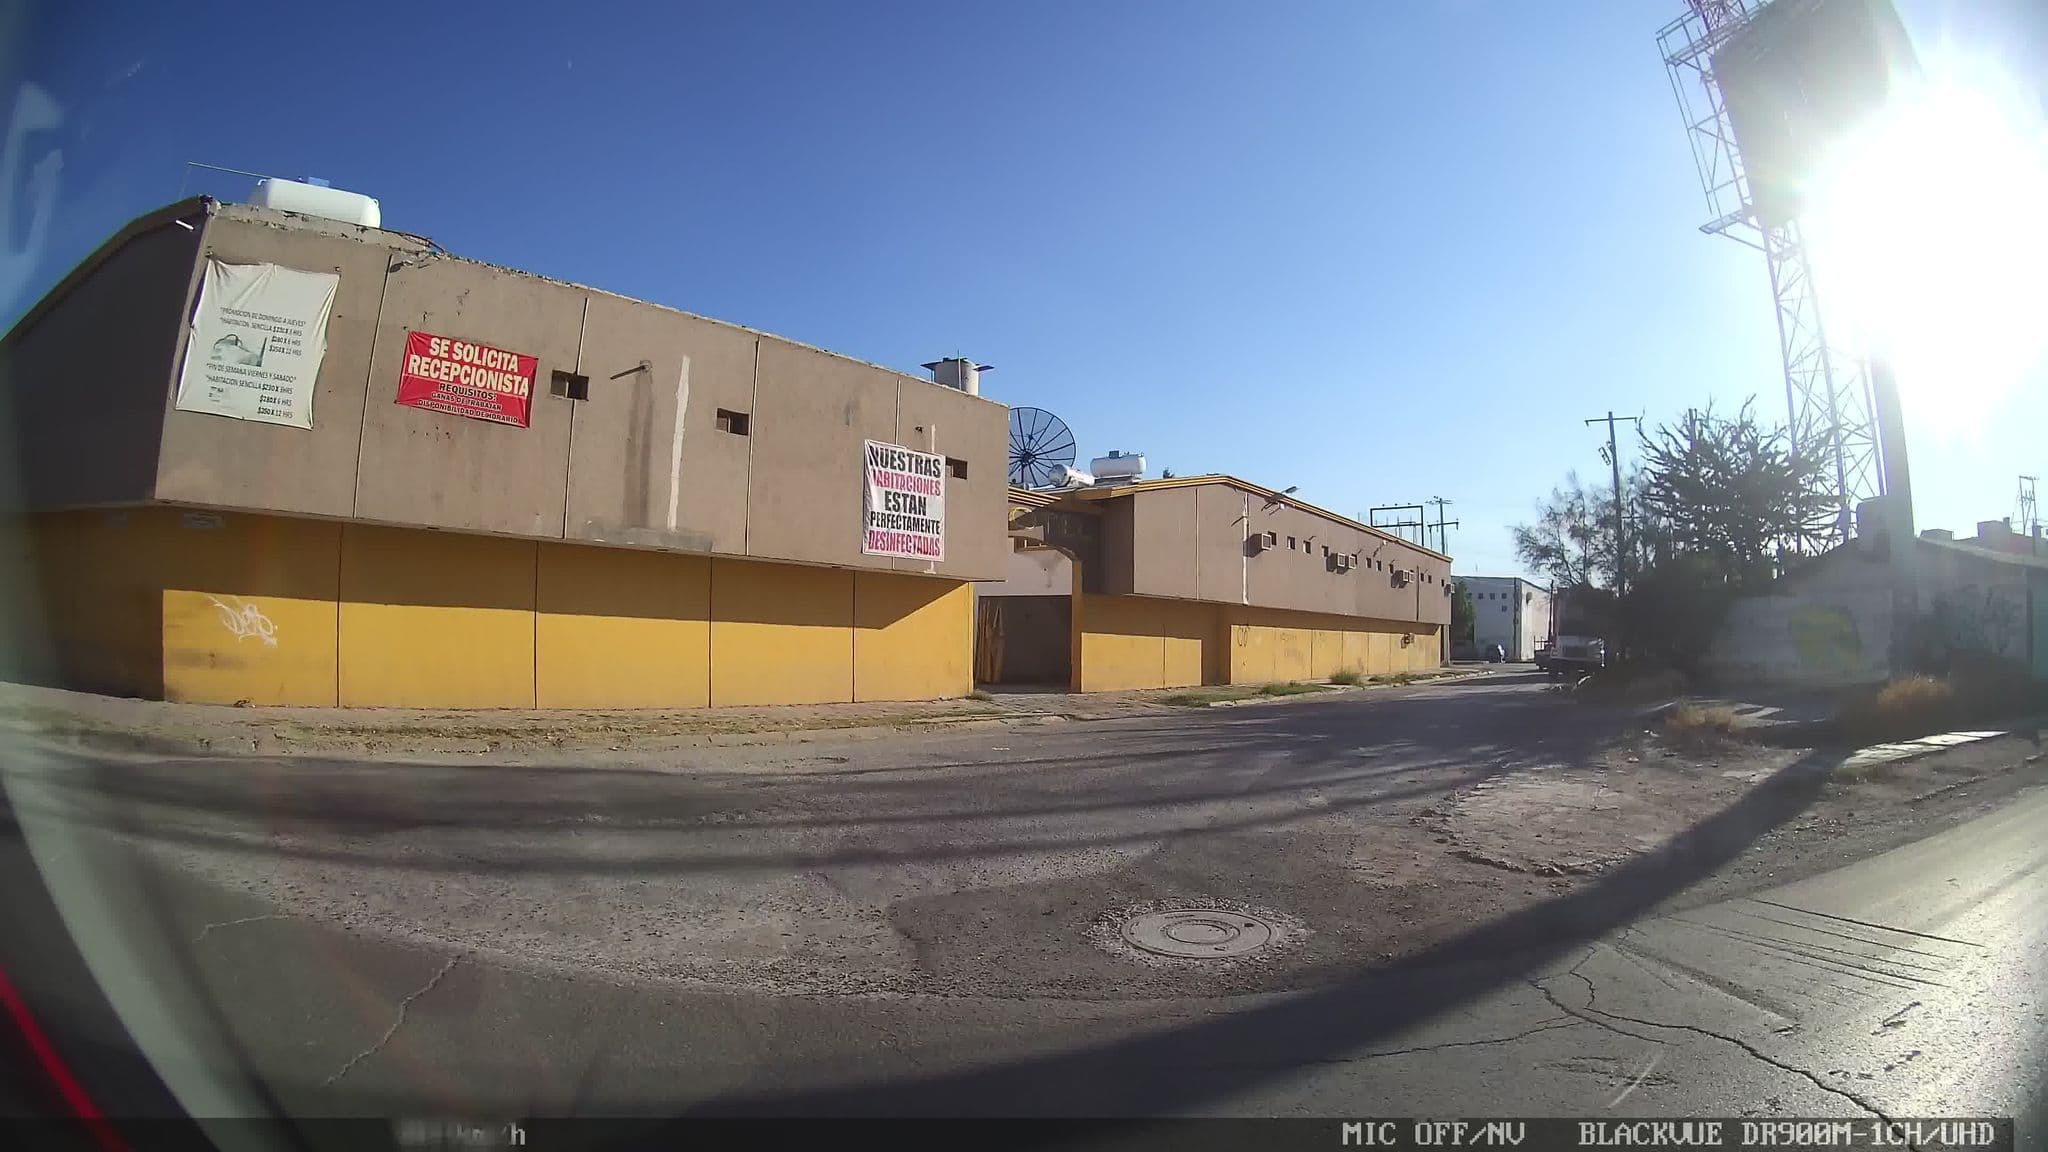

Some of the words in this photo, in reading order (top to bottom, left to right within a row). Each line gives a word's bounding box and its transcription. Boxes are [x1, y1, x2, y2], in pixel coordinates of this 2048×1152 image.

[429, 337, 450, 358] SE
[452, 341, 519, 373] SOLICITA
[408, 354, 529, 397] RECEPCIONISTA
[432, 392, 455, 403] GANAS
[439, 383, 497, 401] REQUISITOS:
[418, 399, 474, 416] DISPONIBILIDAD
[869, 445, 941, 478] NUESTRAS
[885, 490, 927, 516] ESTAN
[870, 511, 940, 535] PERFECTAMENTE
[868, 529, 940, 557] DESINFECTADAS
